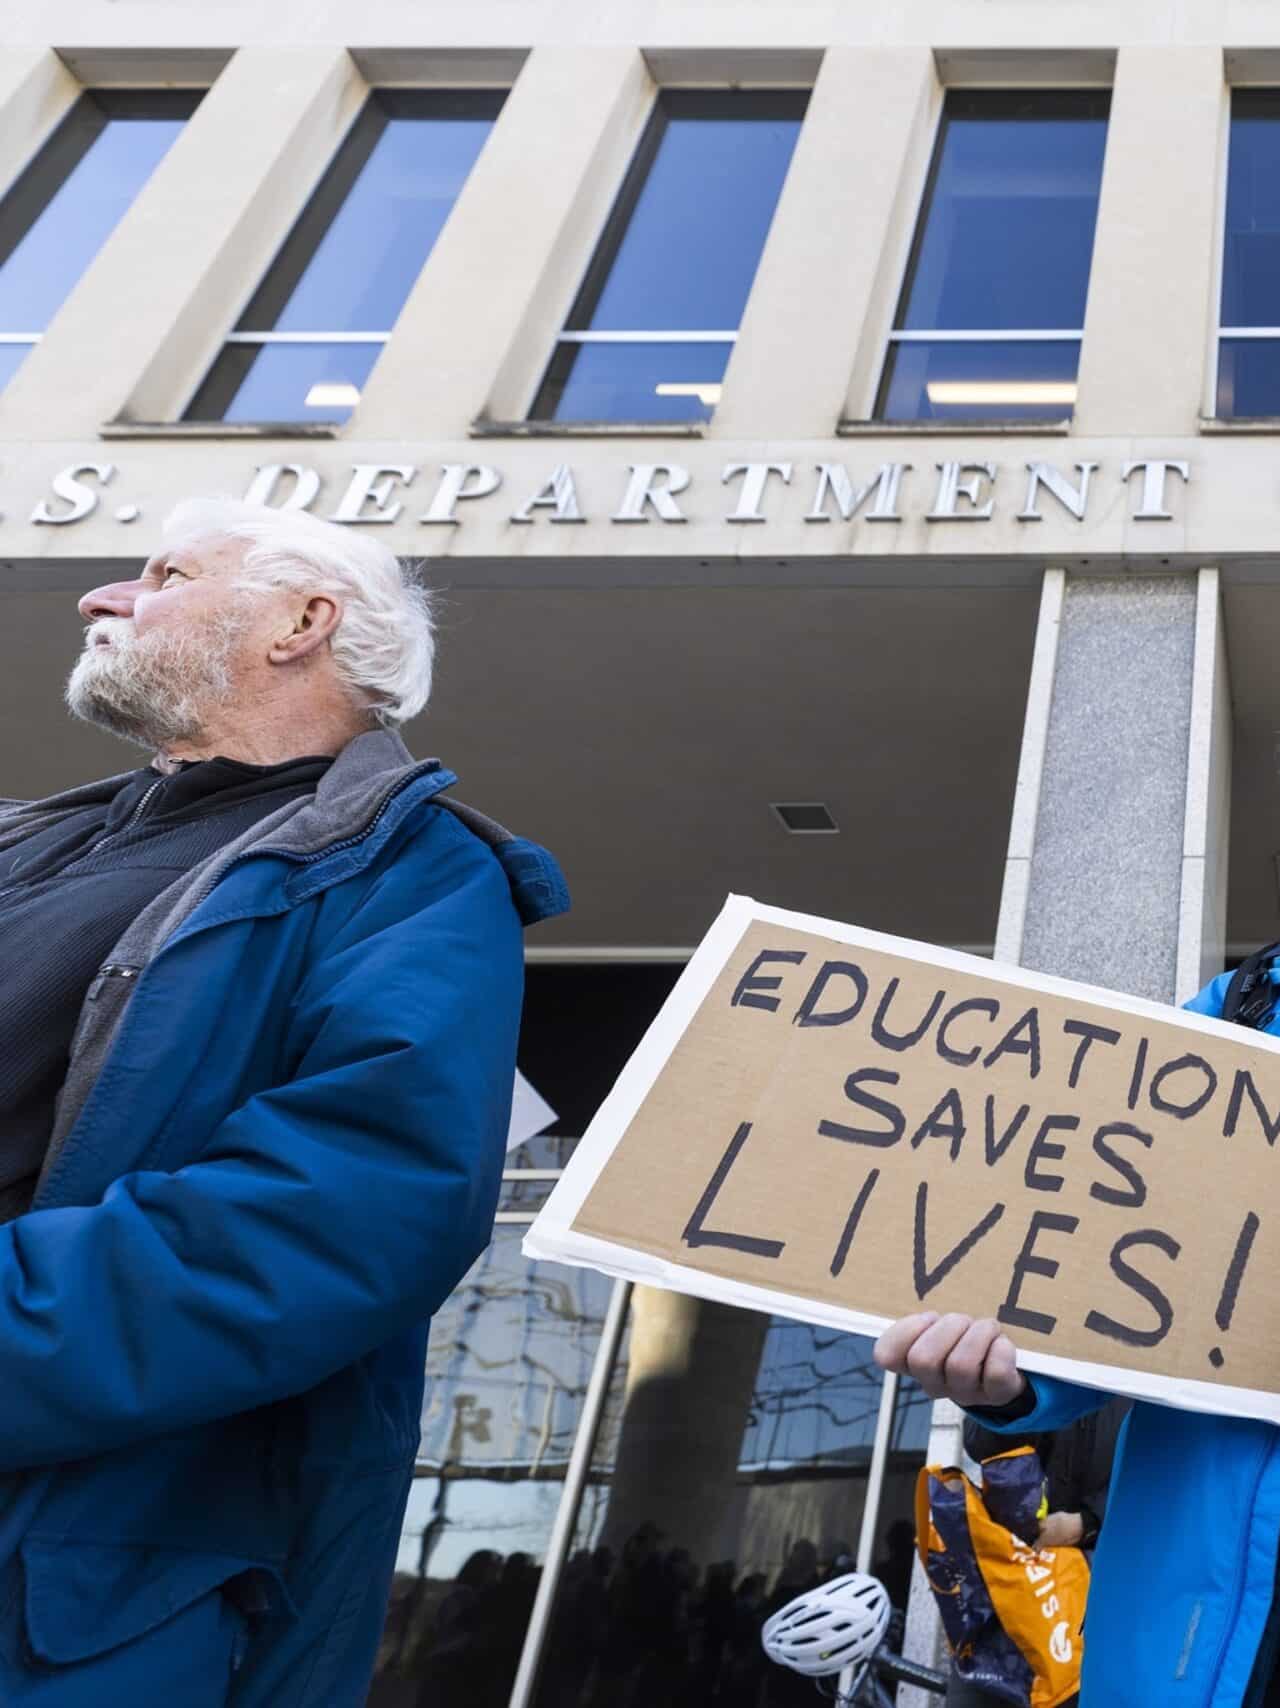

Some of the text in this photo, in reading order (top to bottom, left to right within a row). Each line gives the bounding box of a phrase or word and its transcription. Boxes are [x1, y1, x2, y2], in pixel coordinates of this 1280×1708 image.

[243, 461, 1189, 525] DEPARTMENT
[818, 1068, 1154, 1208] SAVES
[683, 1121, 1261, 1368] LIVES!
